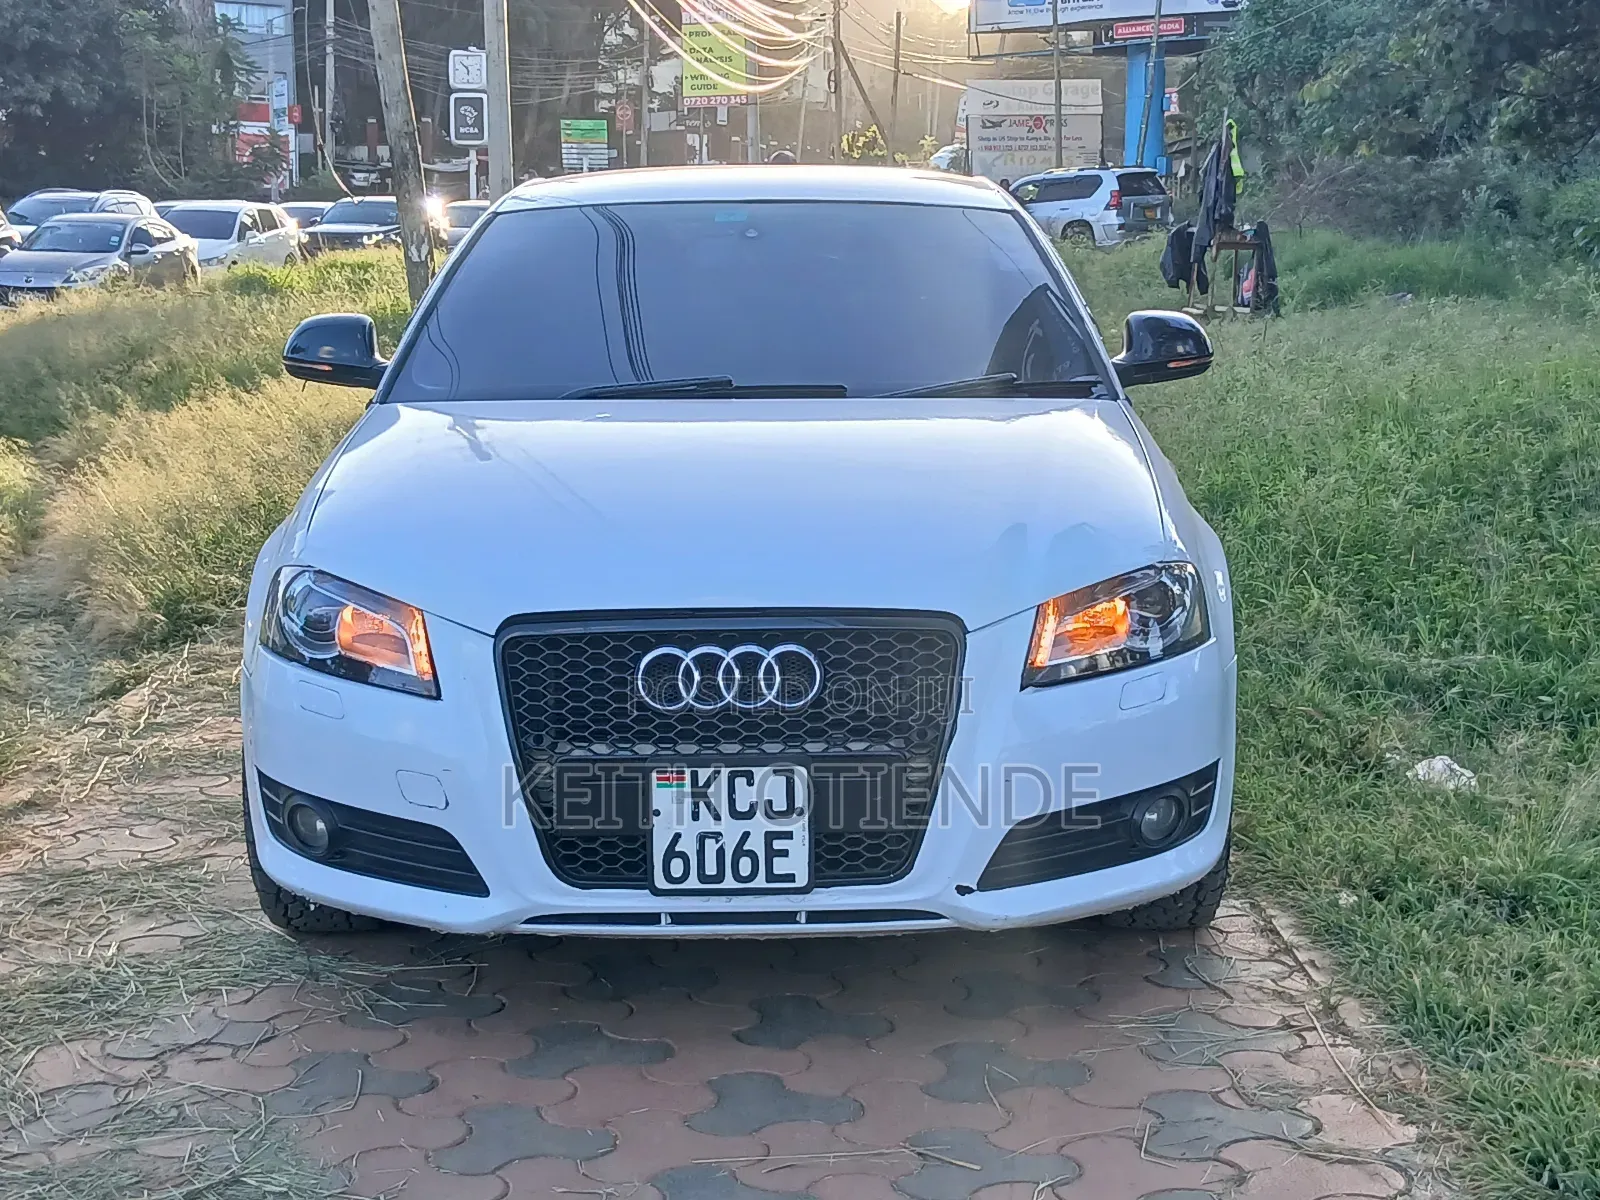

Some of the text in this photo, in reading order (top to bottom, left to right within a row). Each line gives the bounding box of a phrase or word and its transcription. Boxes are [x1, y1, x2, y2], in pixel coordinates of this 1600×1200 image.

[1117, 24, 1150, 34] ALLIANCE
[690, 73, 730, 81] WRIG
[690, 83, 718, 91] GUIDE
[1042, 82, 1100, 99] Grage
[683, 95, 748, 106] 0720 270 345
[690, 768, 796, 822] KCJ
[662, 830, 796, 884] 606E
